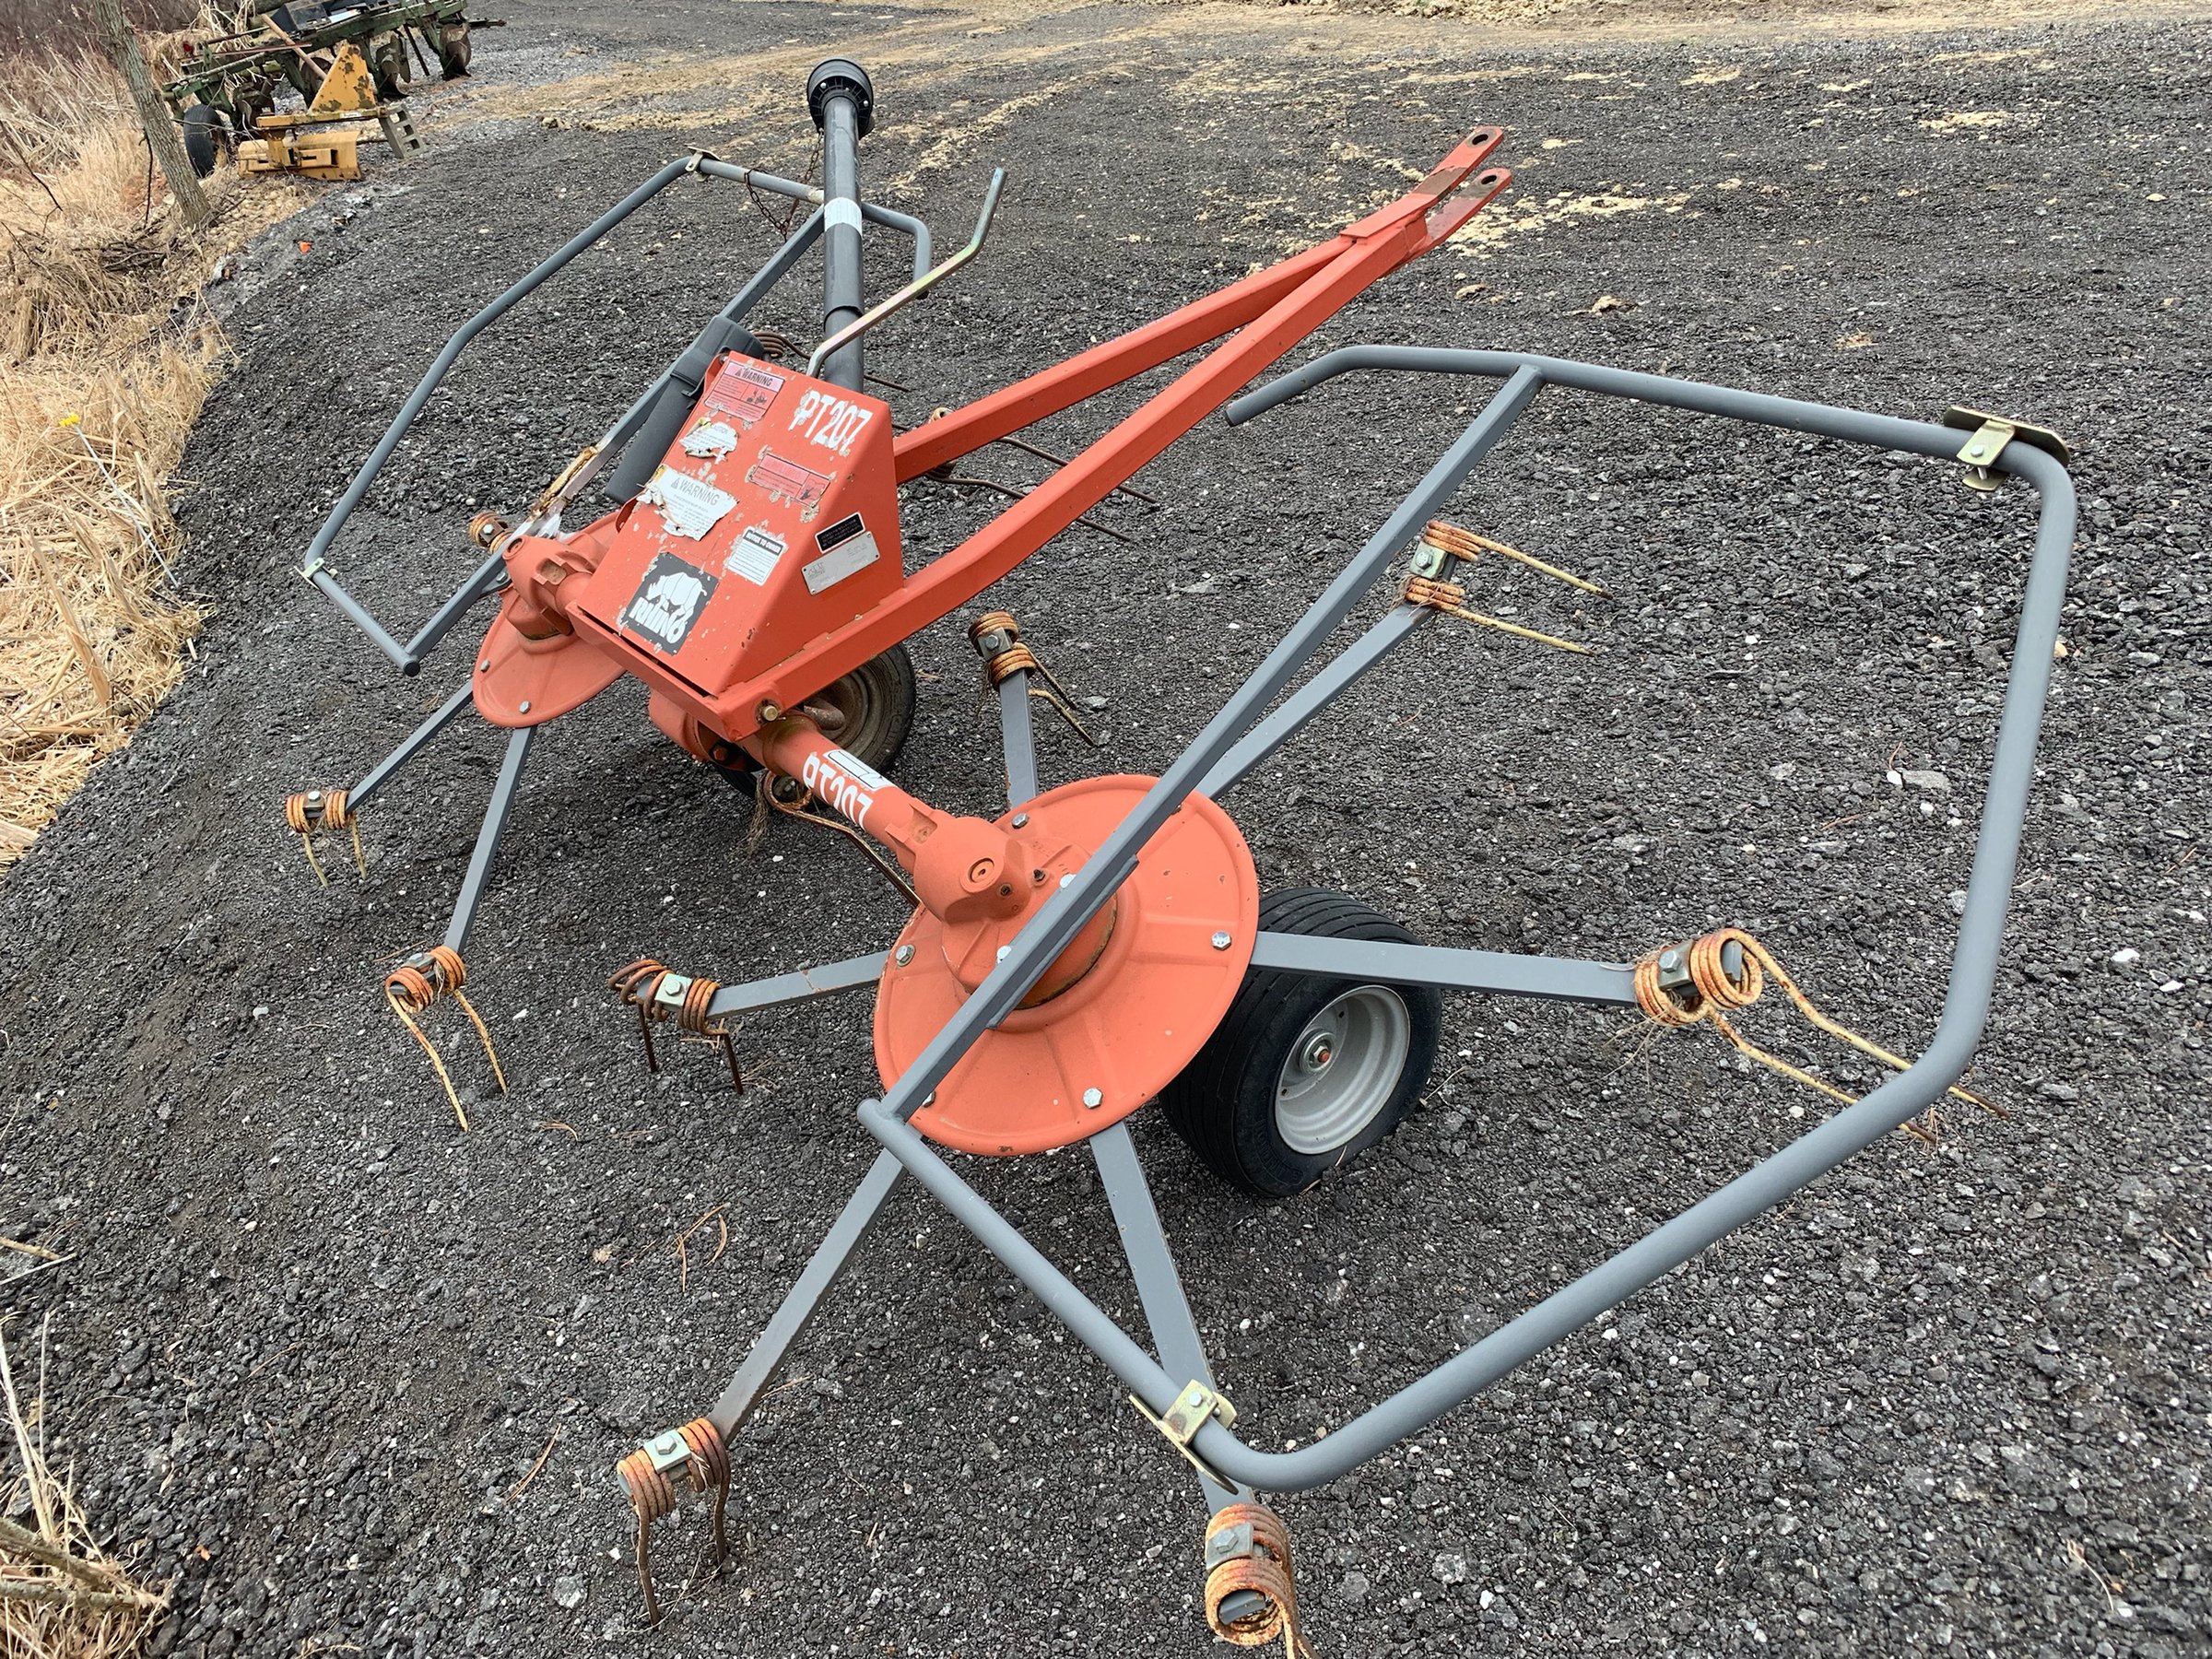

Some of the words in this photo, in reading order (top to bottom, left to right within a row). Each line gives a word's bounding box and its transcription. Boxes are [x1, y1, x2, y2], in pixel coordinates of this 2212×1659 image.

[741, 367, 773, 387] WARNING
[788, 390, 873, 454] PT207
[679, 478, 721, 506] WARNING
[628, 596, 688, 644] RHINO
